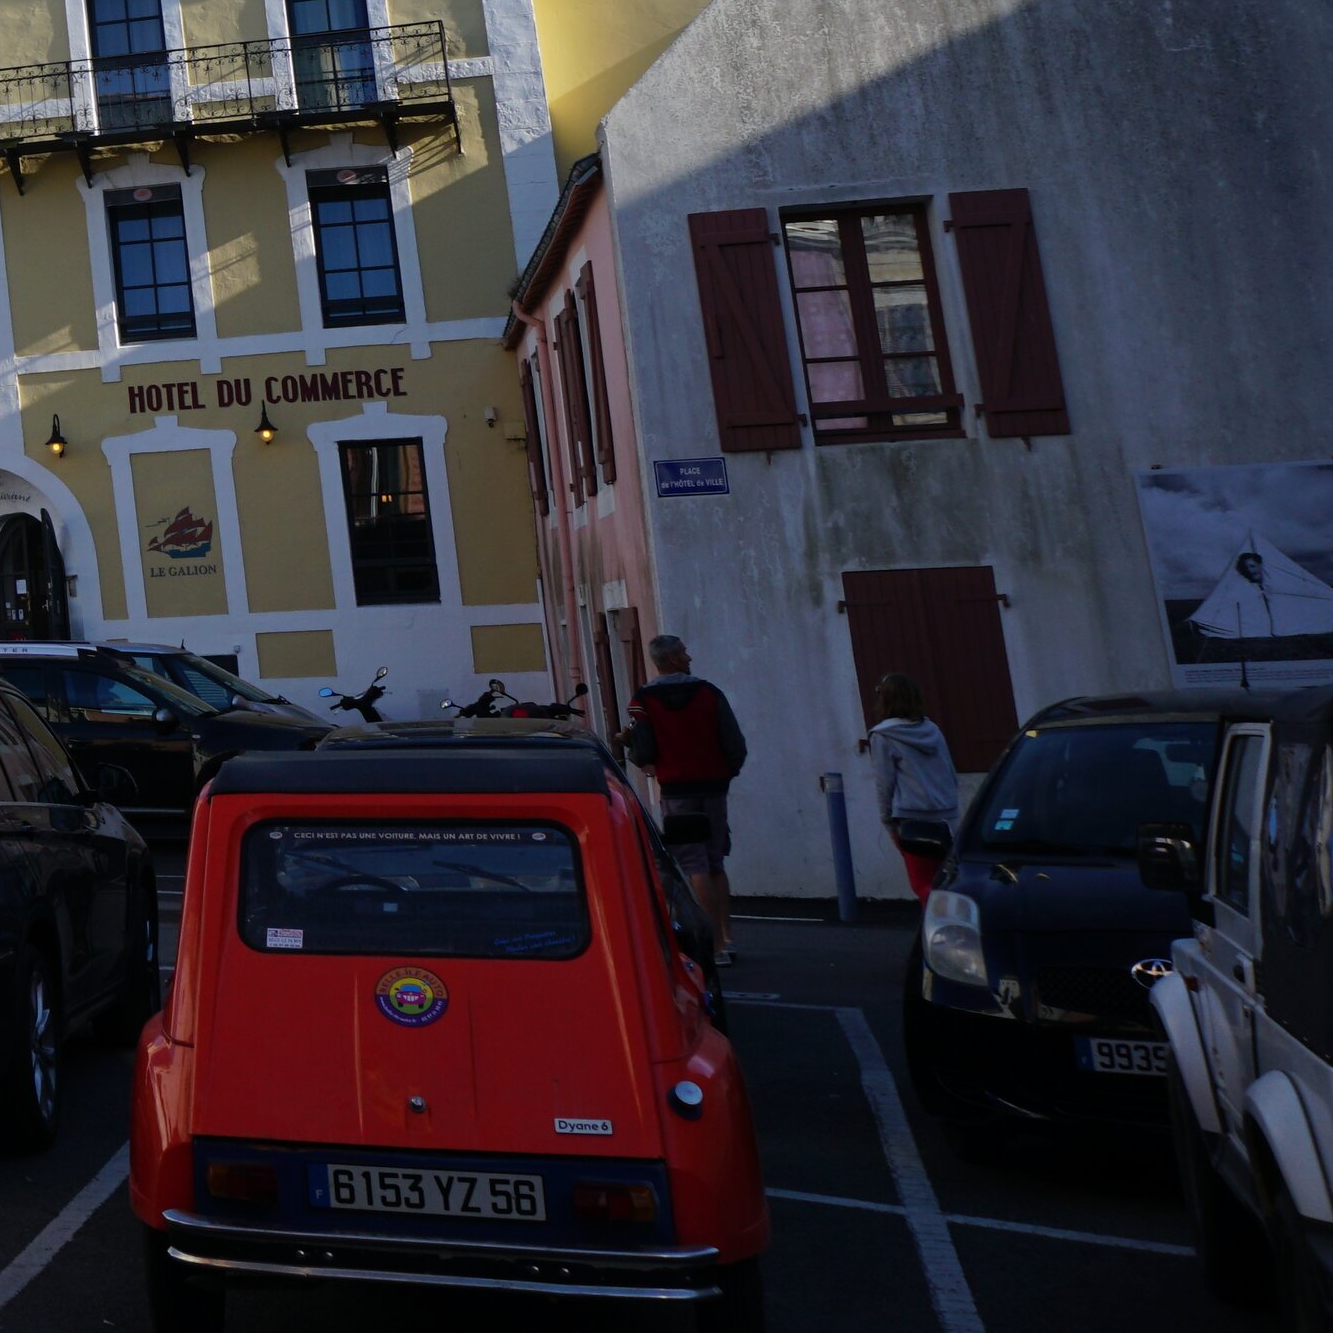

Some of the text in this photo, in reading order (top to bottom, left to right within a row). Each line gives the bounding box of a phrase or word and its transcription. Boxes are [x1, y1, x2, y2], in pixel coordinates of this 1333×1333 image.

[128, 368, 408, 413] HOTEL DU COMMERCE
[679, 467, 702, 475] PLACE
[704, 478, 724, 486] VILLE
[150, 565, 216, 577] LE GALION
[419, 832, 441, 840] MAIS
[443, 832, 455, 840] UN
[558, 1120, 609, 1132] Dyane 6
[315, 1169, 537, 1216] F 6153 YZ 56
